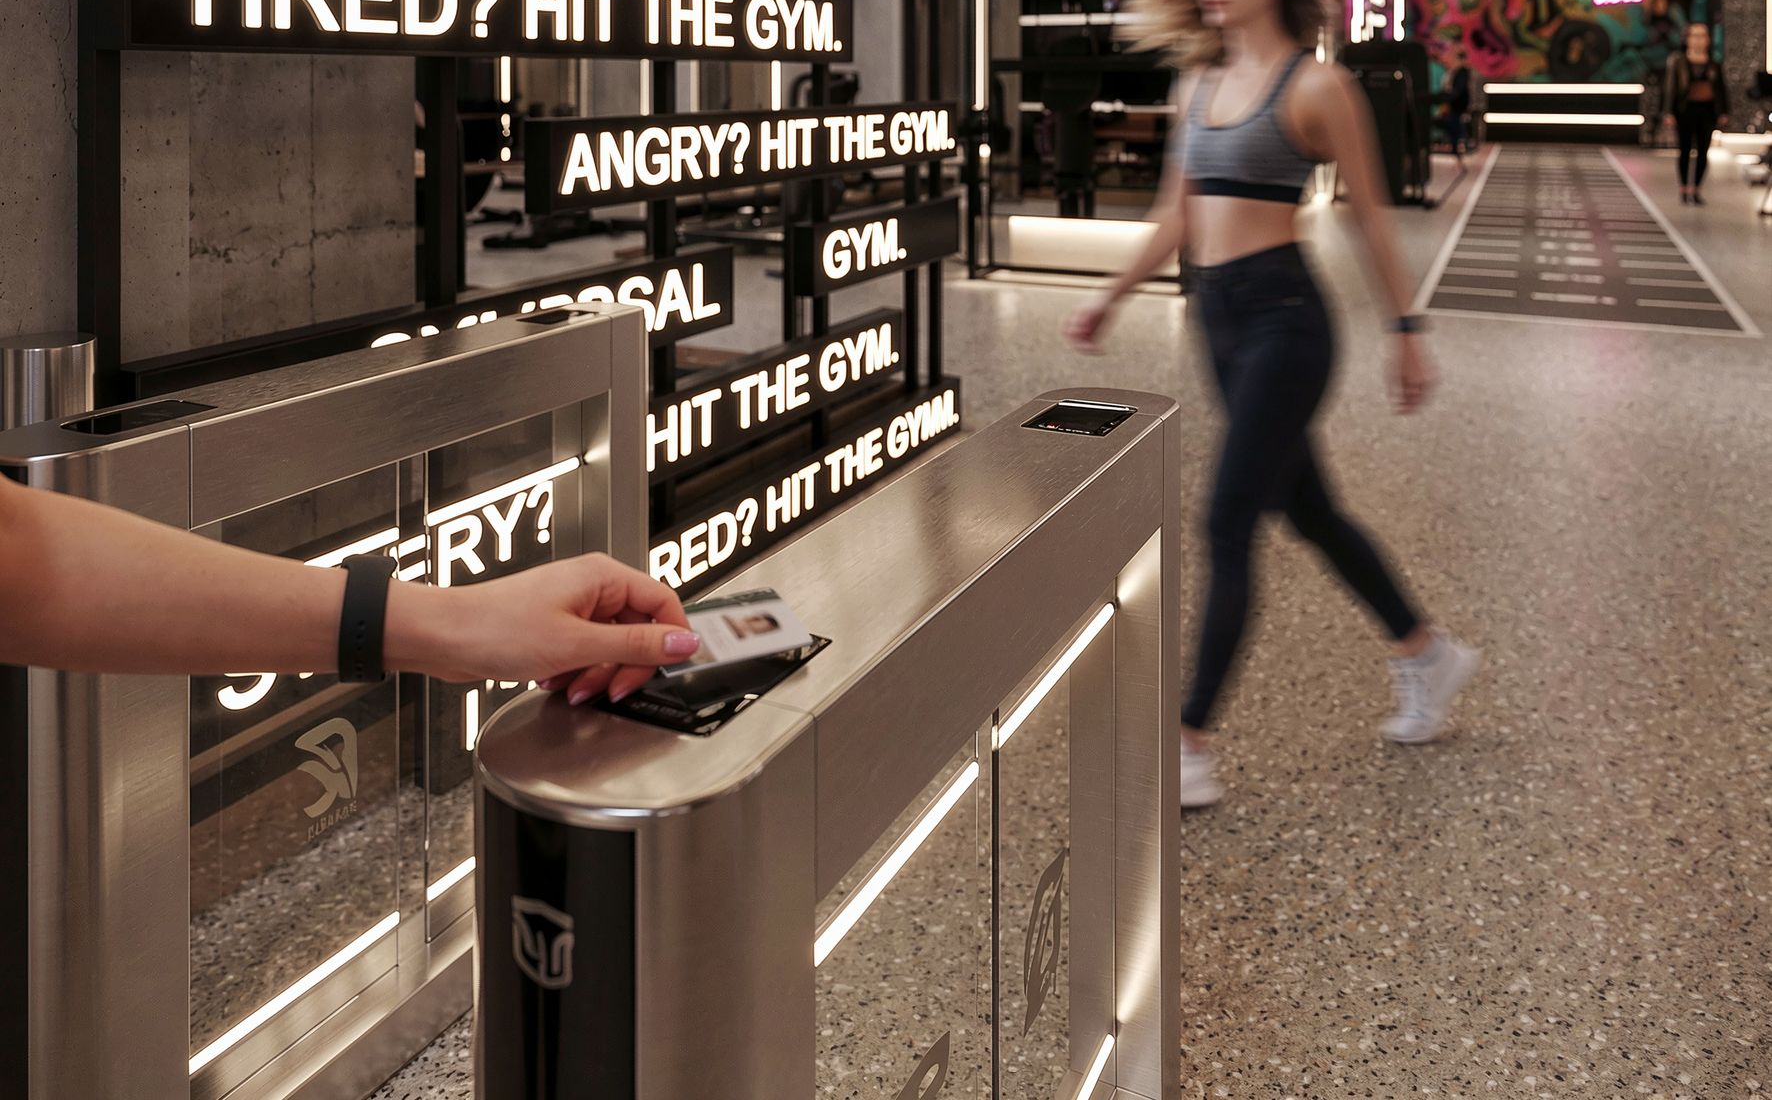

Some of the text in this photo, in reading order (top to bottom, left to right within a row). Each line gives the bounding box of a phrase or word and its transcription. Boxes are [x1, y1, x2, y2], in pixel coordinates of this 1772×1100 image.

[560, 109, 956, 196] ANGRY? HIT THE GYM.
[821, 217, 908, 280] GYM.
[645, 322, 900, 473] HIT THE GYM.
[765, 460, 822, 533] HIT
[823, 426, 884, 494] THE
